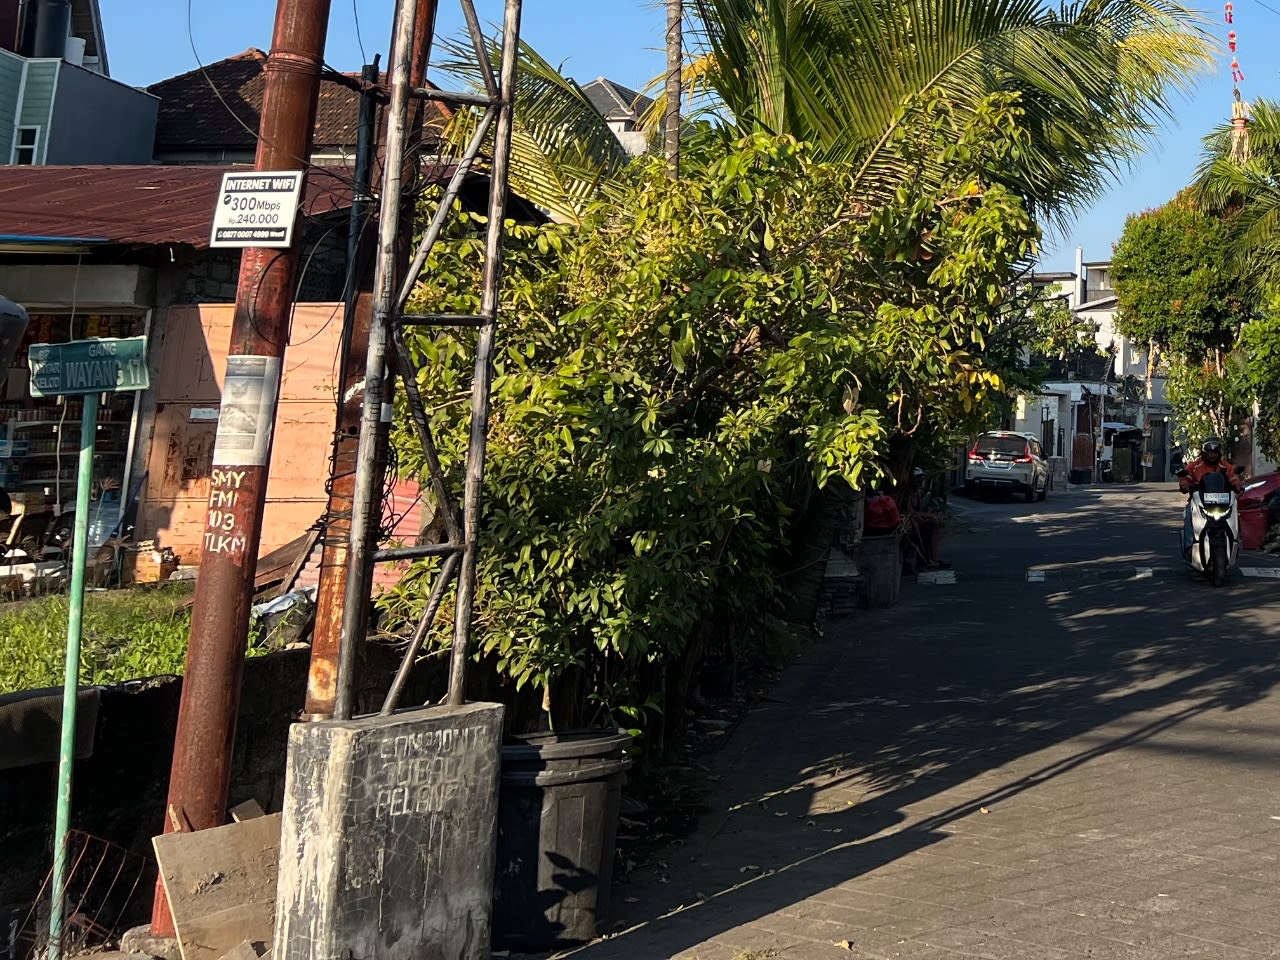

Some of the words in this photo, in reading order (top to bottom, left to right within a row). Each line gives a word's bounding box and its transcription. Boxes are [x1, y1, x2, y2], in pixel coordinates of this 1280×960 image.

[225, 179, 271, 190] INTERNET
[272, 178, 295, 190] WIFI
[88, 343, 117, 357] GANG
[66, 360, 124, 388] WAYANG
[127, 358, 141, 385] 17
[211, 468, 245, 489] SMY
[208, 509, 235, 530] 103
[204, 533, 247, 554] TLKM
